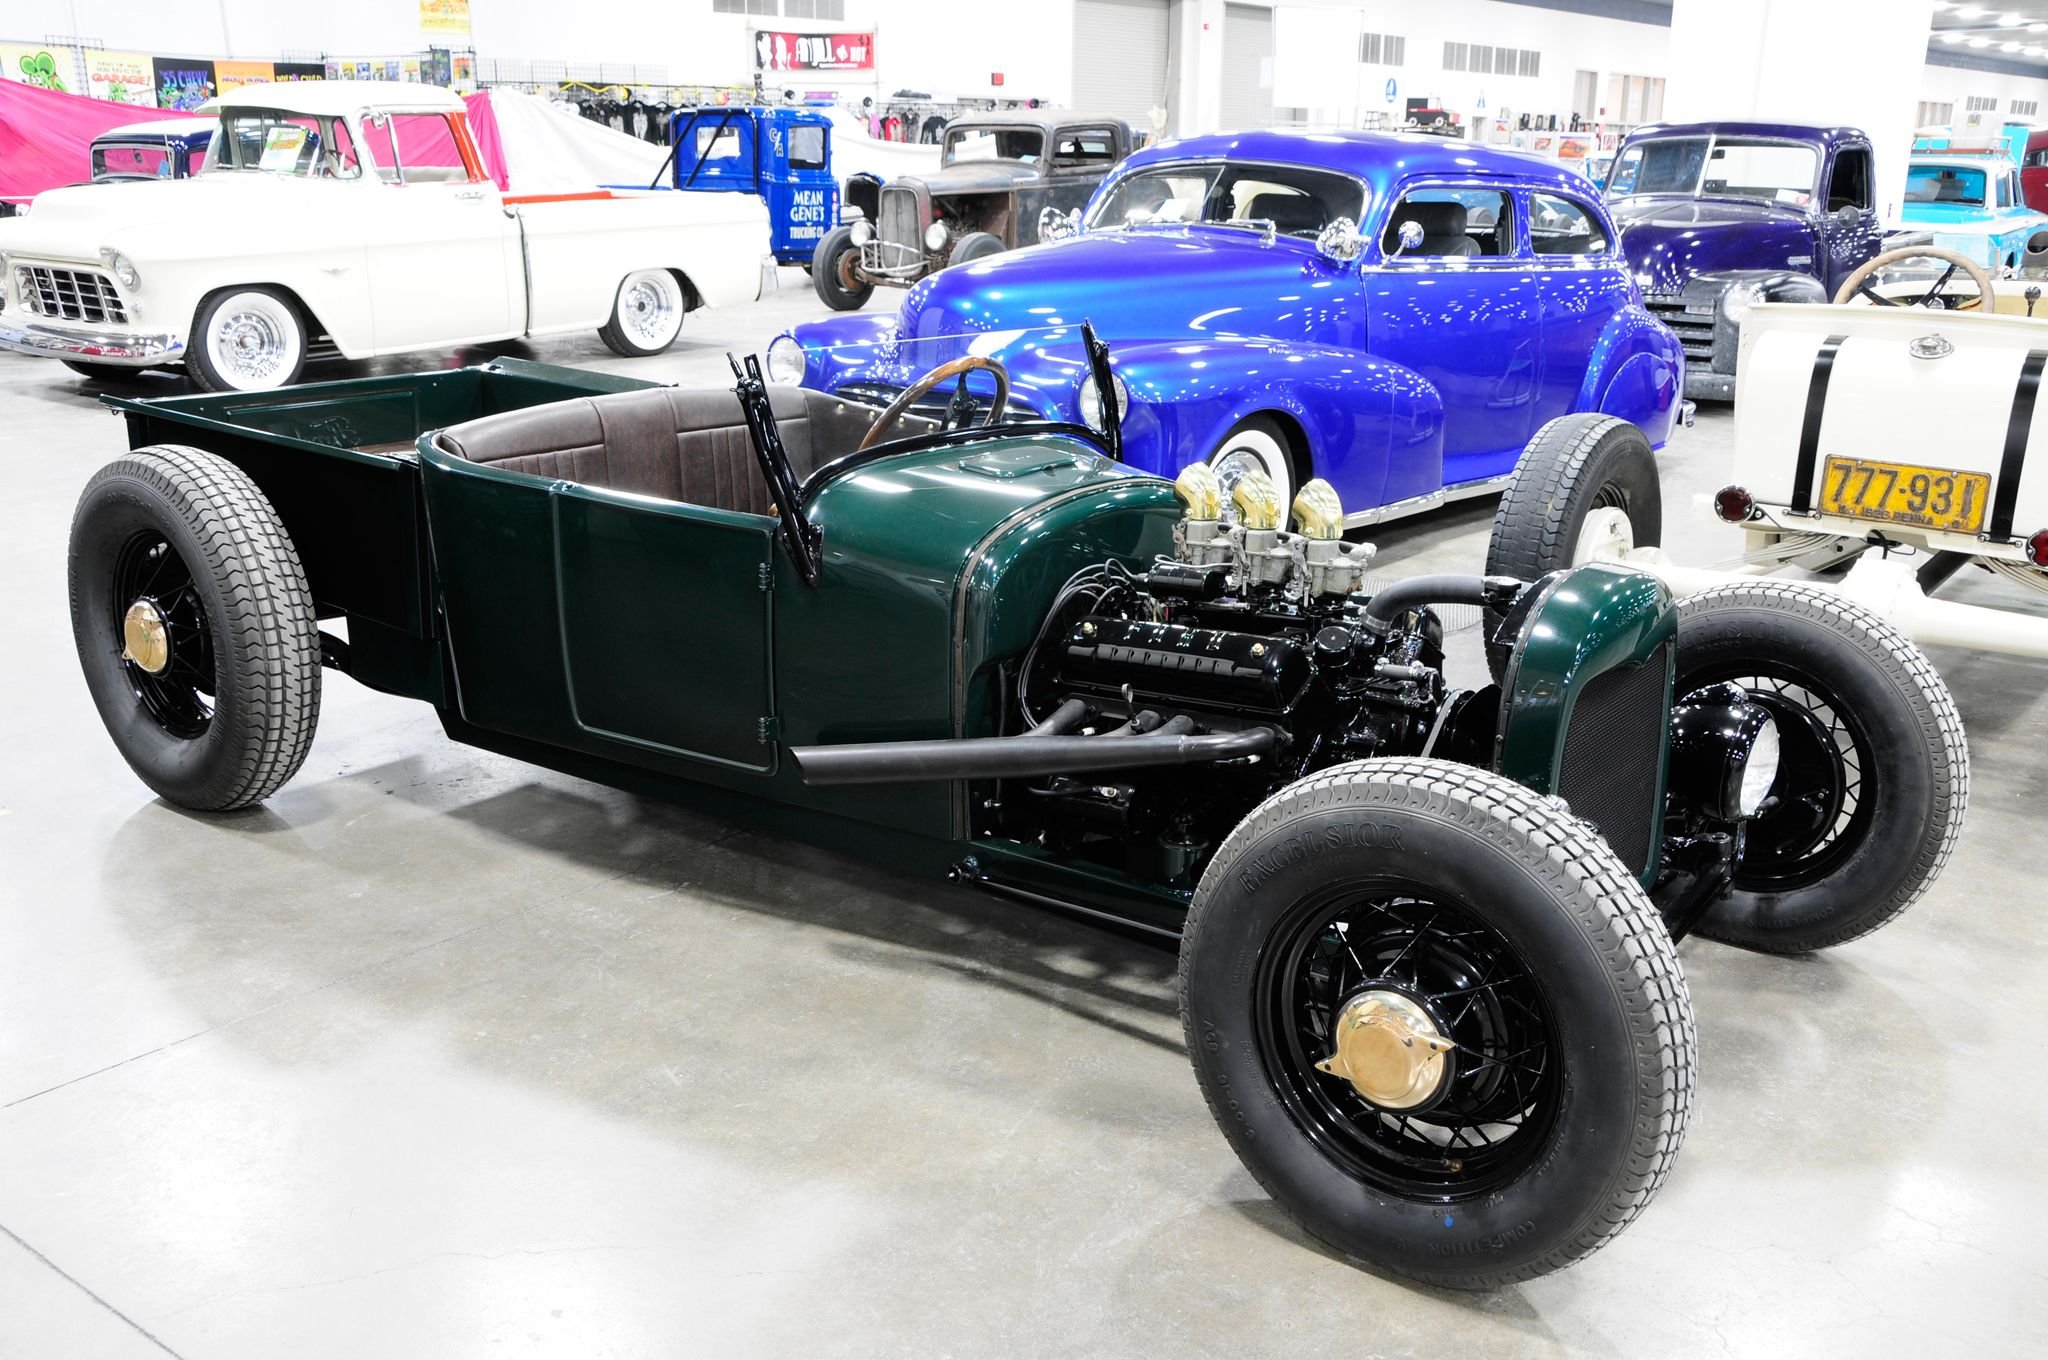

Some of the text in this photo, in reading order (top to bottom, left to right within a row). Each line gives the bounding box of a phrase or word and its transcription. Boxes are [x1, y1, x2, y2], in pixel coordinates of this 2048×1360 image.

[177, 70, 209, 88] CHEVY
[793, 189, 824, 206] MEAN
[790, 205, 825, 222] GENE'S
[1237, 820, 1407, 896] EXCELSIOR
